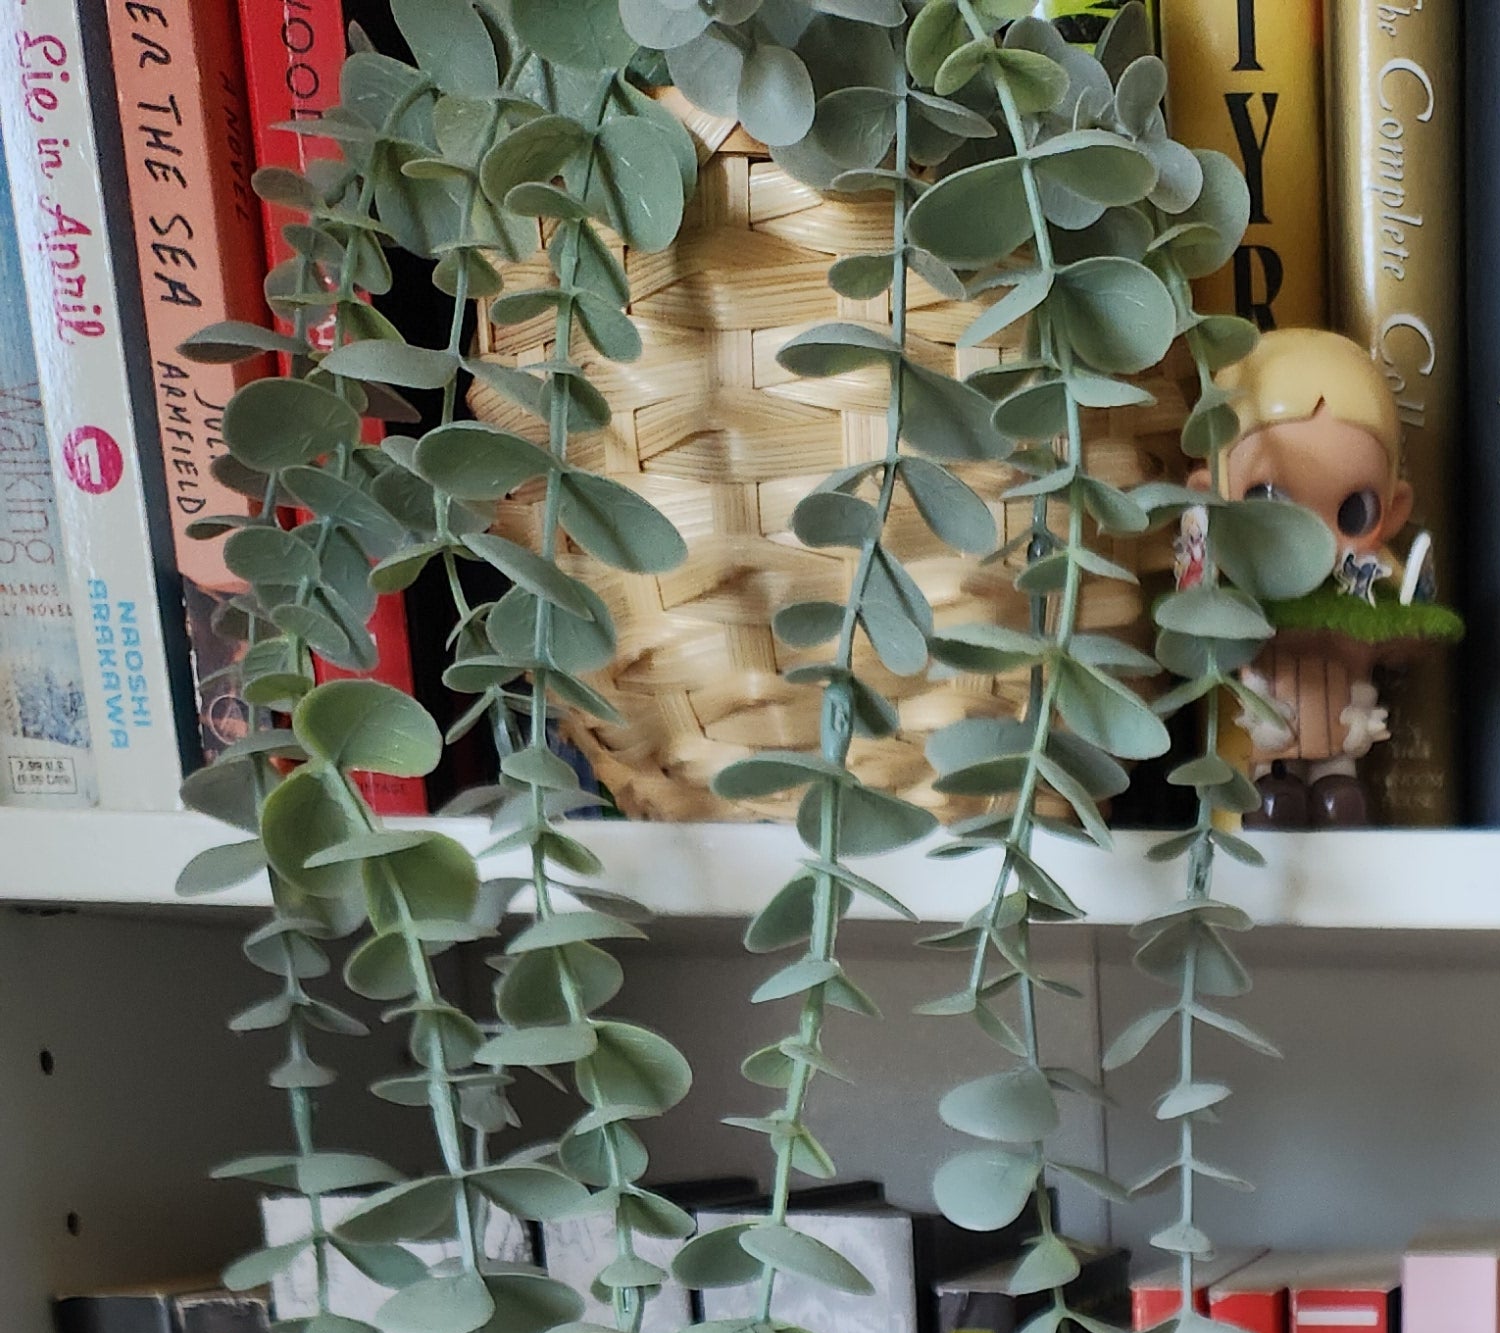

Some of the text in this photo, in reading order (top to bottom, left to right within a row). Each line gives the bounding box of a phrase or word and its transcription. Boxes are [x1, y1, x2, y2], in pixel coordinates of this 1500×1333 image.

[1377, 0, 1422, 38] he
[15, 30, 105, 345] Lie in April
[138, 94, 188, 189] THE
[1372, 58, 1435, 281] Complete
[150, 214, 202, 308] SEA
[156, 360, 206, 515] ARMFIELD
[87, 579, 130, 750] ARAKAWA
[117, 601, 152, 729] NAOSHI
